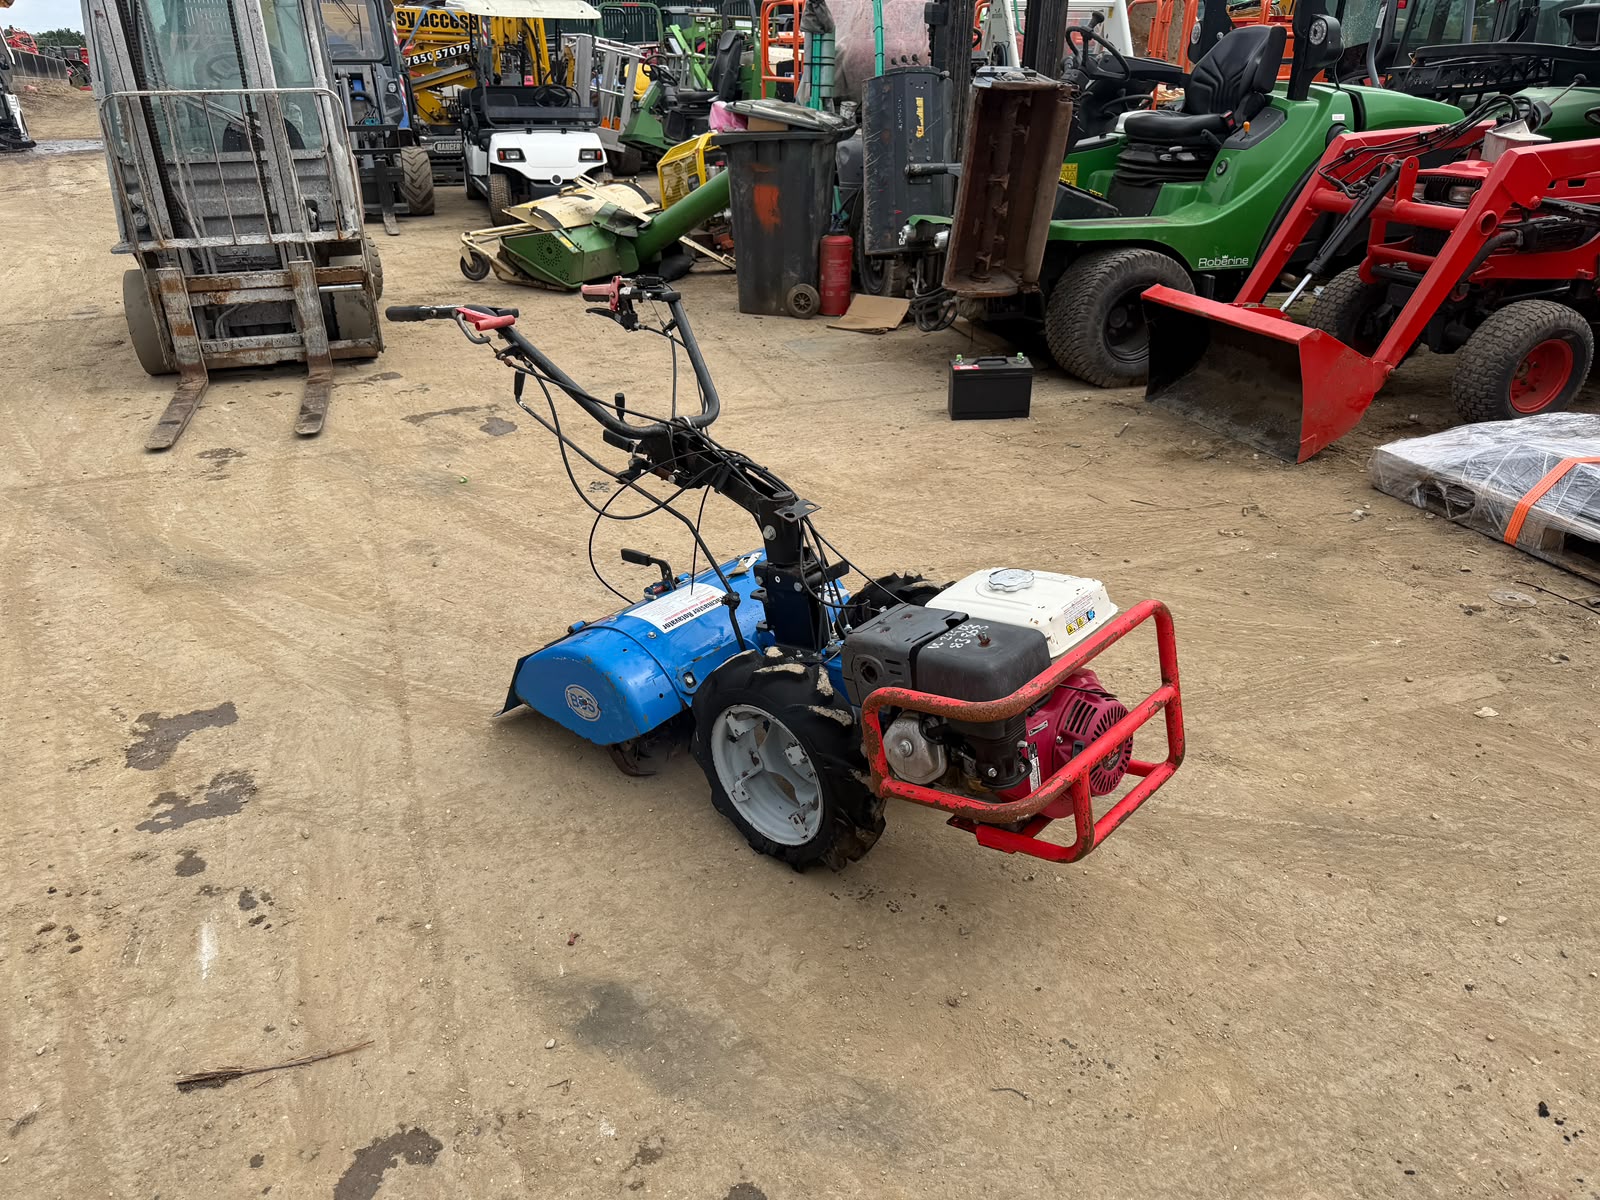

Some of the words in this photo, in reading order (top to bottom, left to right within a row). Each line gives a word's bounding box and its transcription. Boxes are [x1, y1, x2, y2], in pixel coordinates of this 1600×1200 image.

[437, 143, 461, 151] RANGER
[1198, 255, 1249, 267] Roberine
[662, 611, 695, 630] Rotavator
